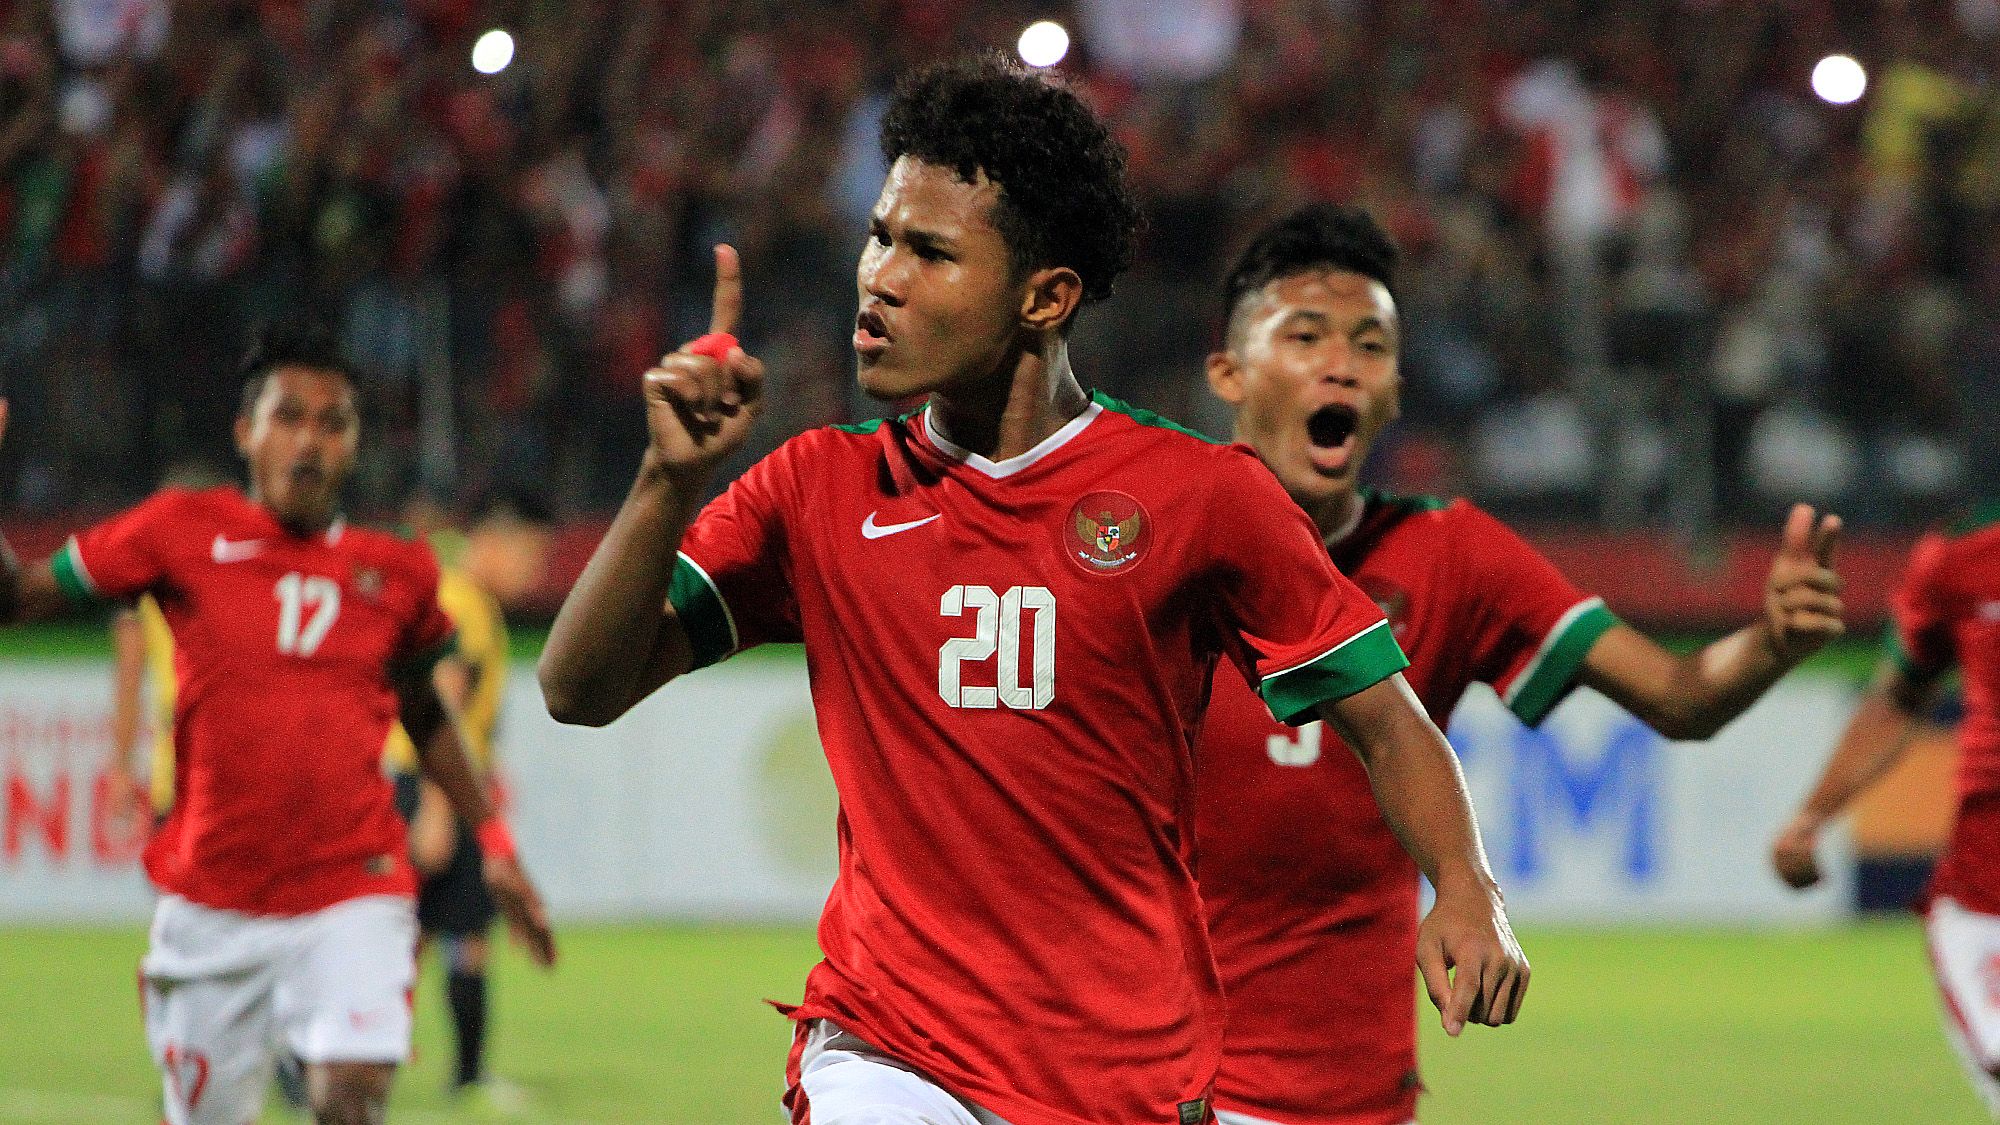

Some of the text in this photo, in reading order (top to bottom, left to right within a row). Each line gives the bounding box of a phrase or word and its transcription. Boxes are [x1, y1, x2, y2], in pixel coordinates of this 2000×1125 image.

[274, 572, 341, 656] 17
[939, 585, 1056, 709] 20
[164, 1043, 209, 1111] 17
